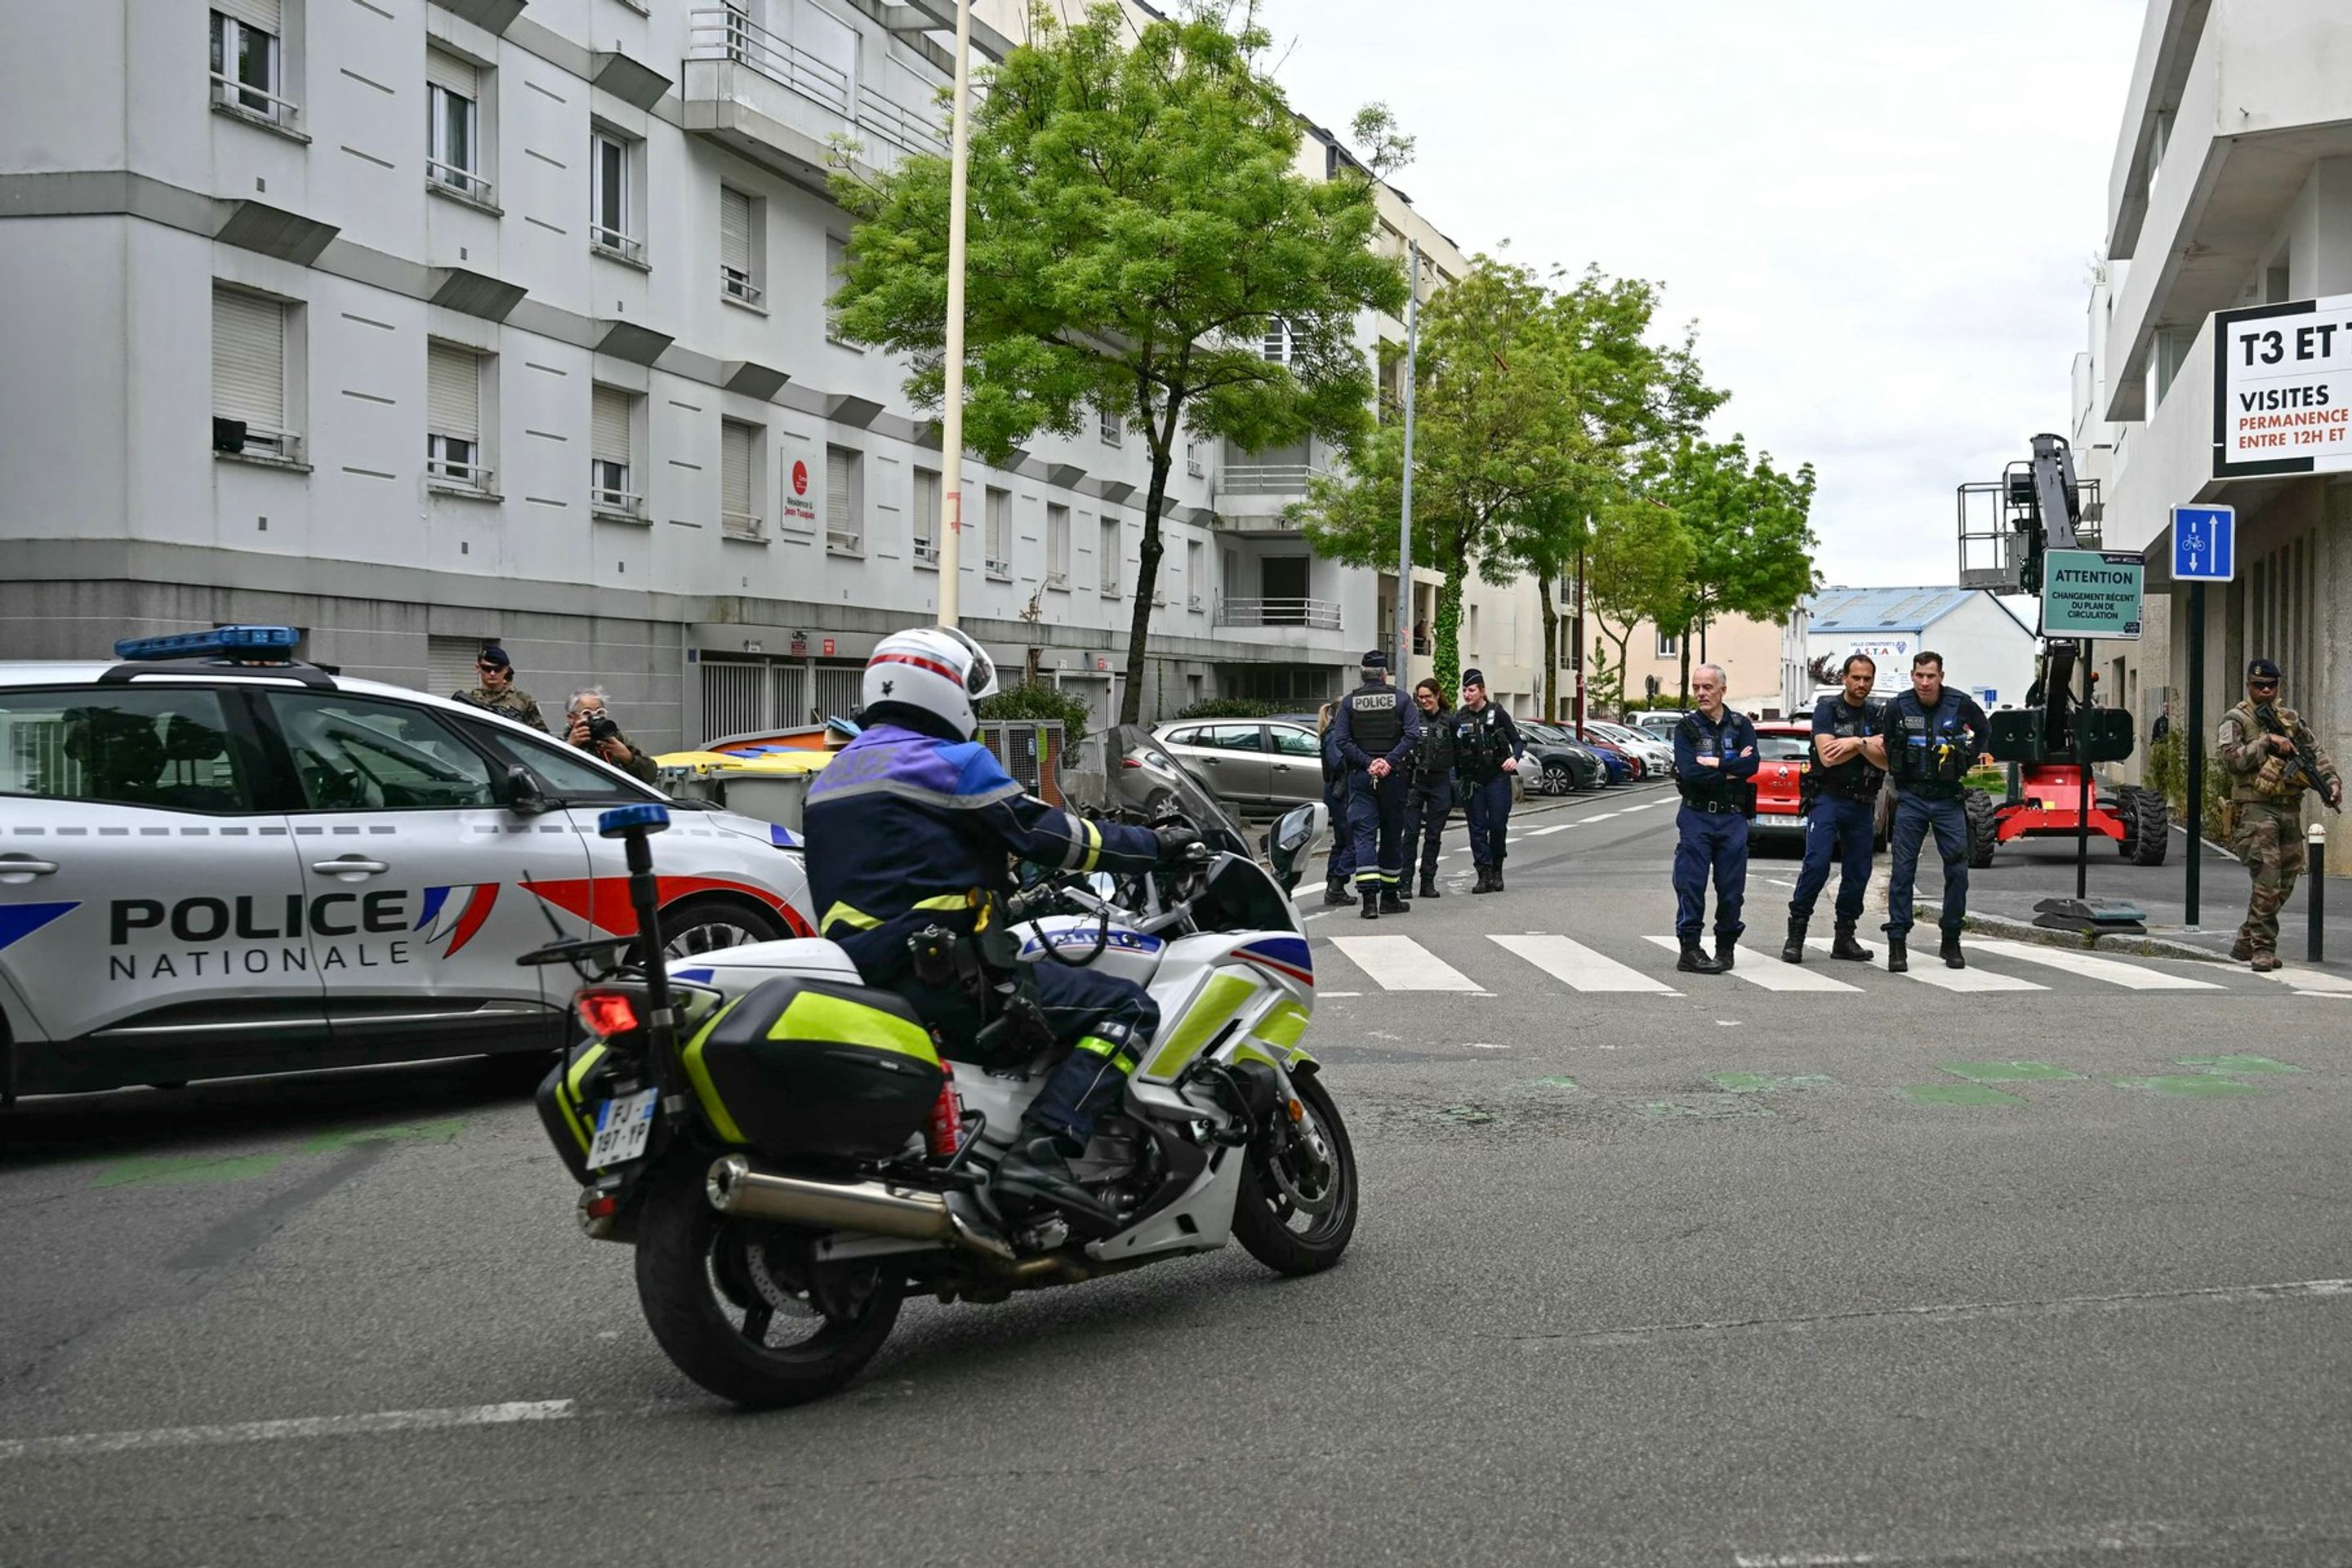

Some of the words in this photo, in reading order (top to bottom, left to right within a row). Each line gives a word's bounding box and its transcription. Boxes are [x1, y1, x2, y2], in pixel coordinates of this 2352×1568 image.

[2239, 330, 2284, 367] T3
[2296, 323, 2337, 360] ET
[2239, 385, 2330, 412] VISITES
[2239, 409, 2349, 430] PERMANENCE
[2239, 432, 2287, 448] ENTRE
[2293, 430, 2323, 444] 12H
[2329, 428, 2345, 442] ET
[2055, 569, 2133, 585] ATTENTION
[2051, 591, 2105, 601] CHANGEMENT
[2106, 593, 2135, 602] RÉCENT
[2072, 601, 2082, 609] DU
[2084, 602, 2104, 610] PLAN
[2105, 603, 2114, 611] DE
[2067, 610, 2118, 620] CIRCULATION
[1355, 695, 1394, 709] POLICE
[110, 890, 408, 945] POLICE
[110, 941, 409, 980] NATIONALE
